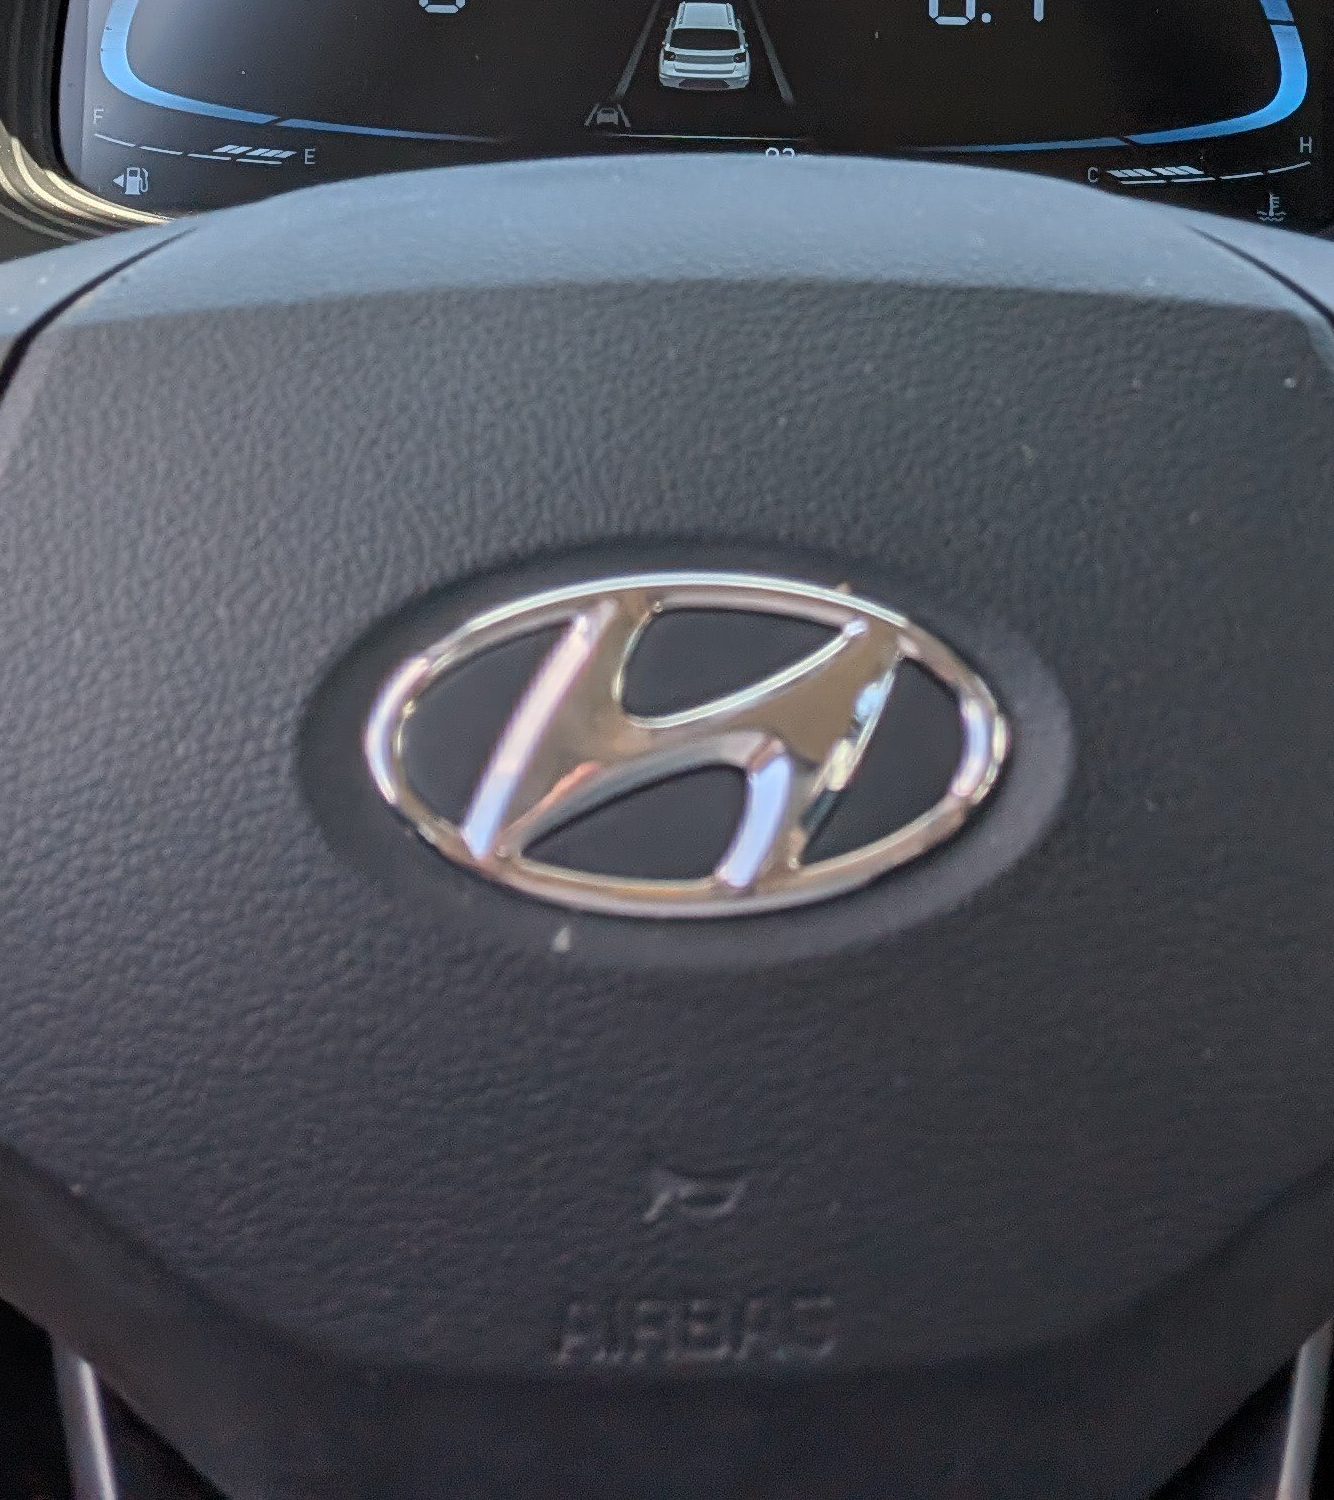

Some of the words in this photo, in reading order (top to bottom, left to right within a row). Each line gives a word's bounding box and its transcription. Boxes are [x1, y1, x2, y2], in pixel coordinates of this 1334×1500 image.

[93, 108, 104, 125] F
[1299, 136, 1313, 155] H
[304, 148, 317, 165] E
[1087, 166, 1099, 183] C
